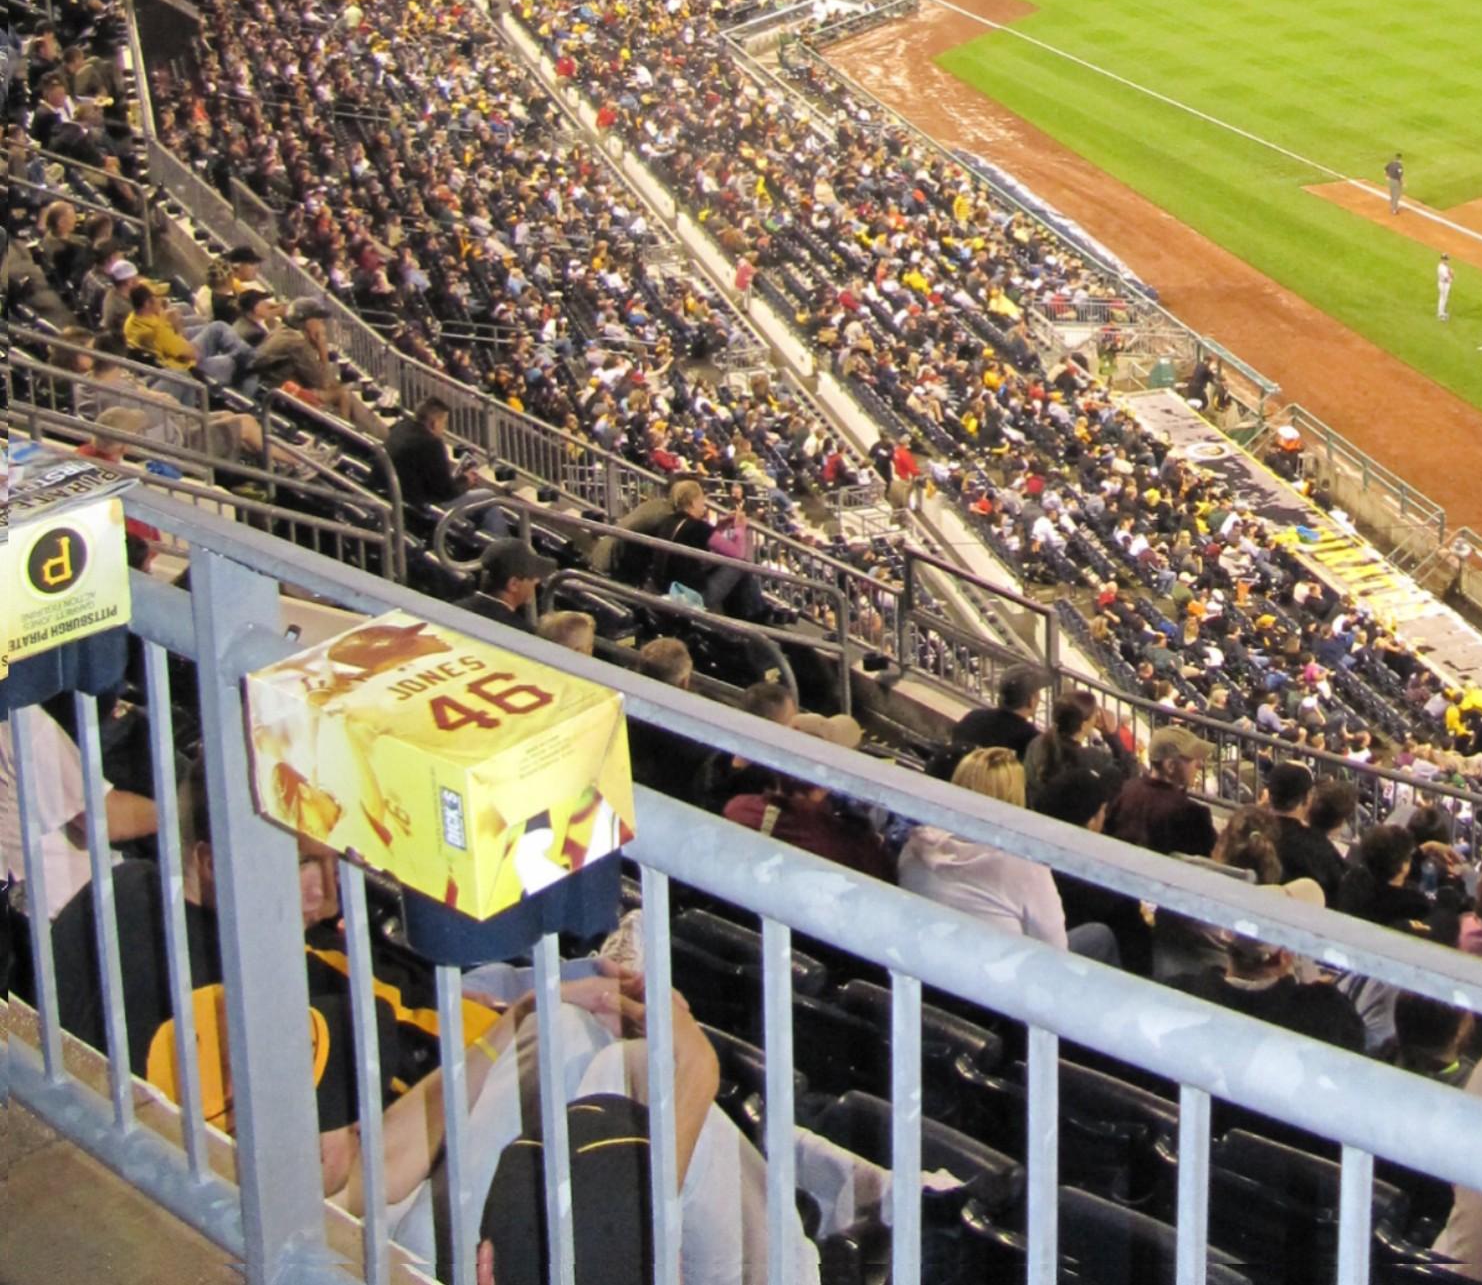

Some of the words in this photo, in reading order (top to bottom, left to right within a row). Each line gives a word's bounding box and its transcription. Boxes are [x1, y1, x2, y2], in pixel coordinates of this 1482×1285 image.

[42, 535, 73, 585] P
[50, 604, 118, 637] PITTSBURGH
[387, 656, 486, 701] JONES
[429, 672, 554, 731] 46
